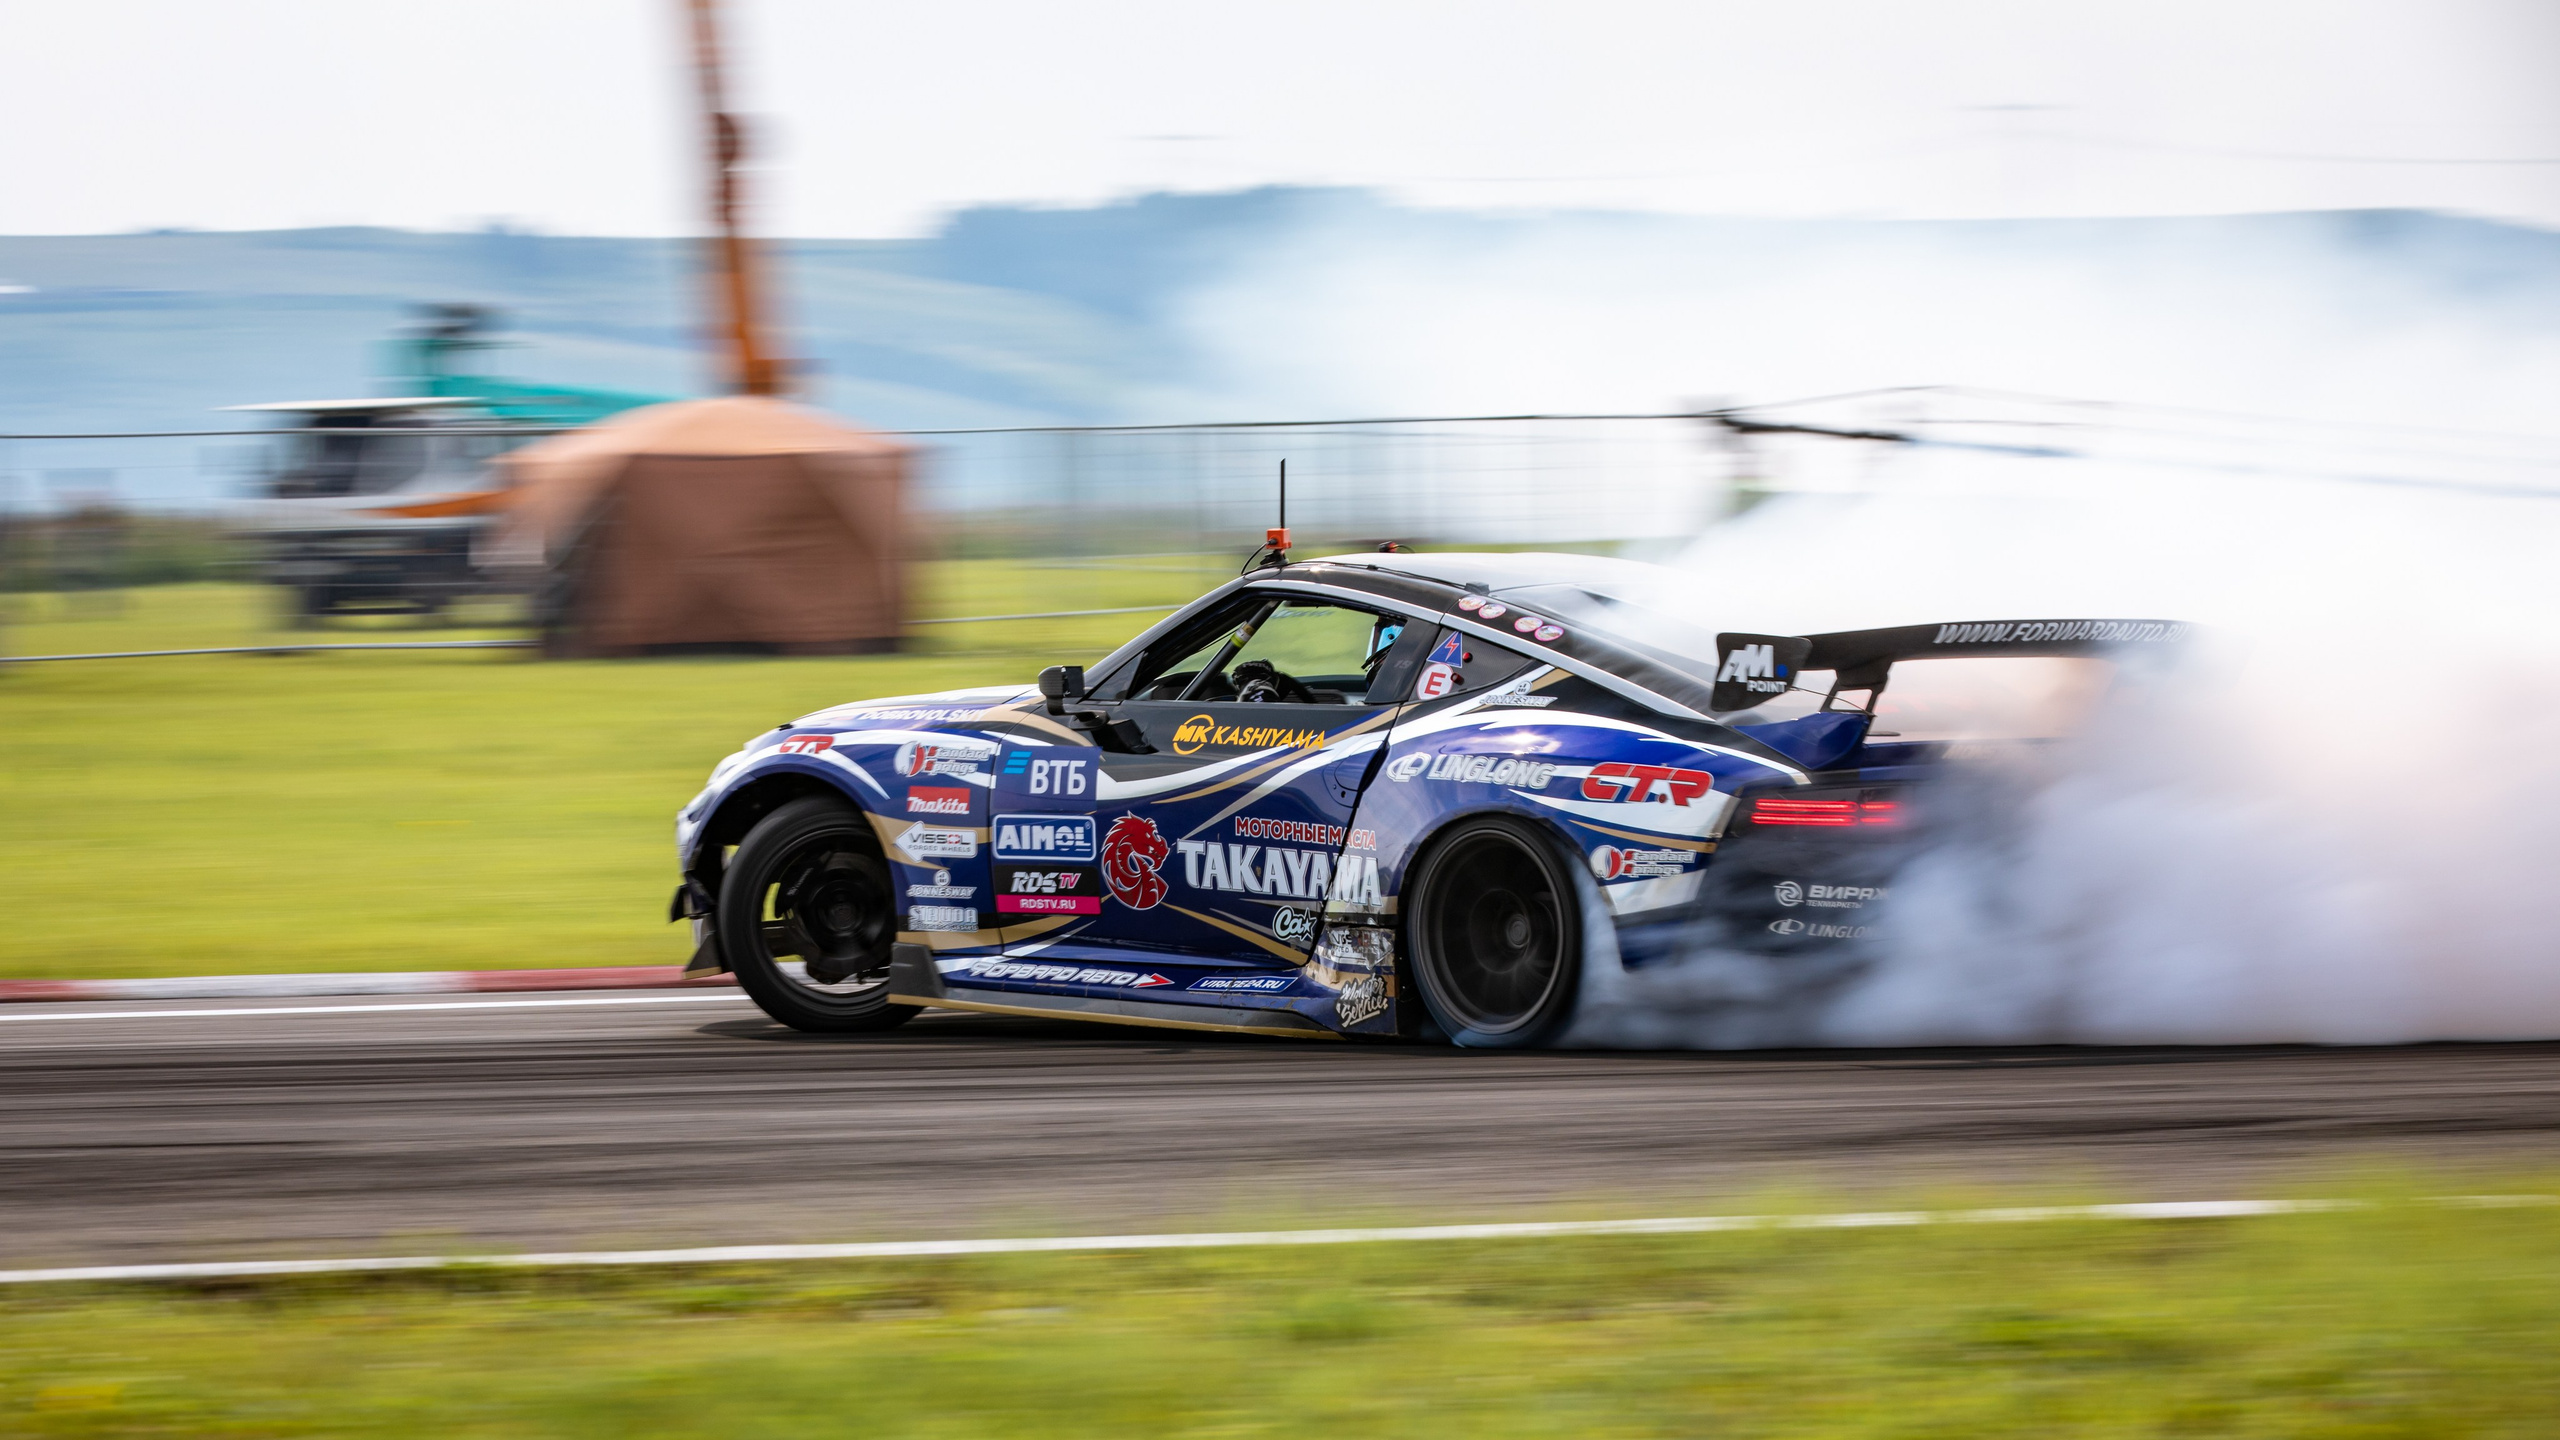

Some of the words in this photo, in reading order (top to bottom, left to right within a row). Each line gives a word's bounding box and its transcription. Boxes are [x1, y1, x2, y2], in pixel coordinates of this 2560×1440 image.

[1933, 621, 2190, 644] WWW.FORWARDAUTO.RU
[1424, 672, 1446, 695] E
[1746, 680, 1788, 693] POINT
[1210, 725, 1326, 749] KASHIYAMA
[1030, 759, 1087, 795] ВТБ
[1427, 755, 1557, 790] LINGLONG
[910, 832, 971, 846] VISSOL
[998, 825, 1092, 852] AIMOL
[1235, 816, 1326, 844] МОТОРНЫЕ
[1177, 838, 1383, 907] TAKAYAMA
[1020, 899, 1077, 910] RDSTV.RU
[1200, 980, 1285, 989] VIRAGE24.RU
